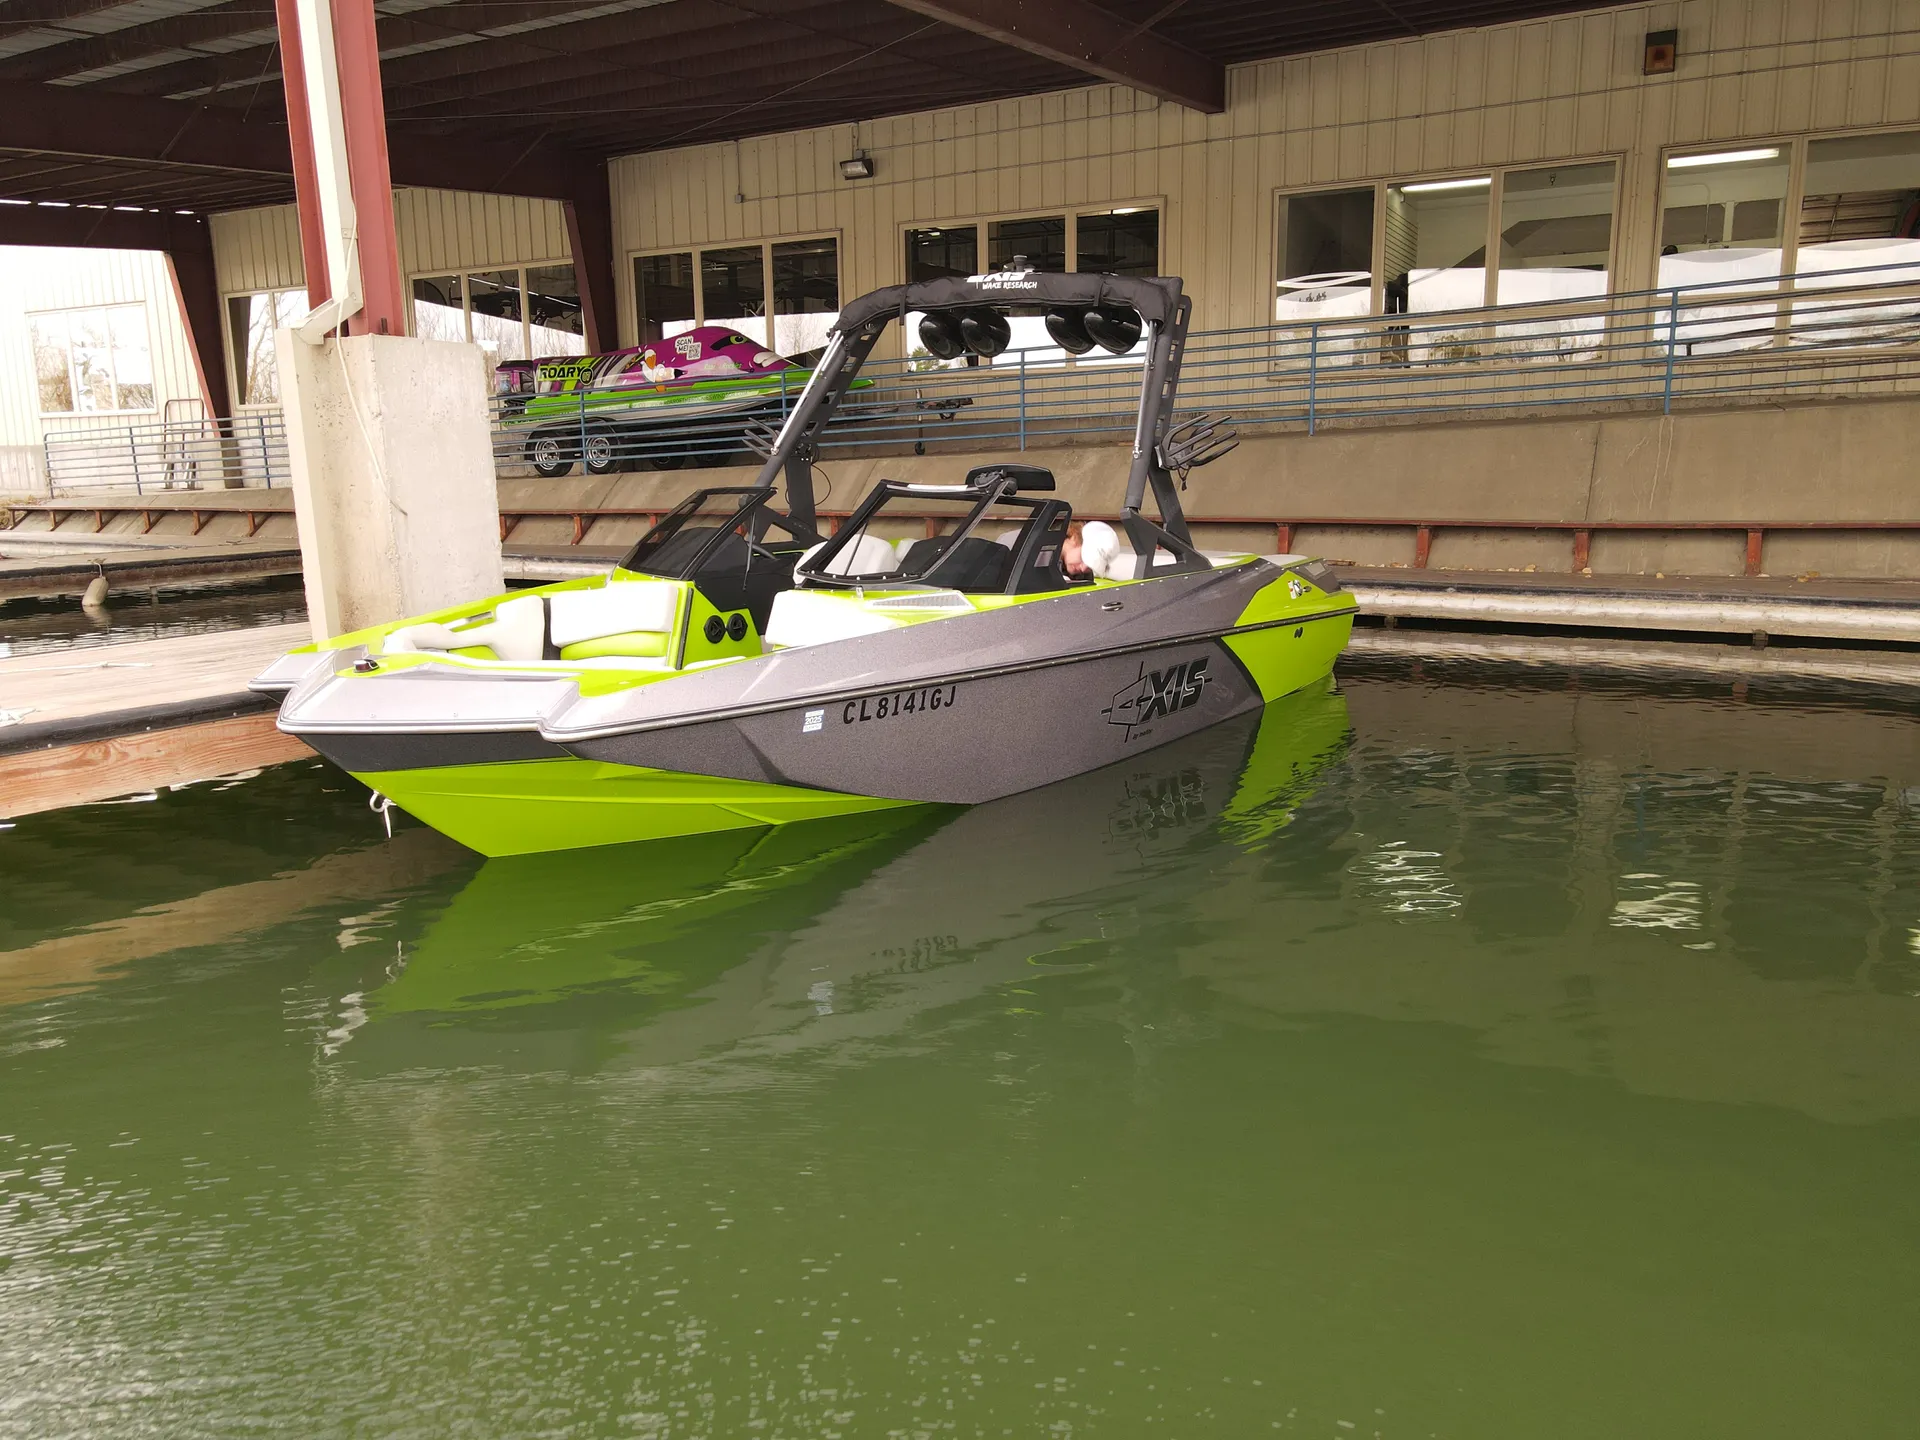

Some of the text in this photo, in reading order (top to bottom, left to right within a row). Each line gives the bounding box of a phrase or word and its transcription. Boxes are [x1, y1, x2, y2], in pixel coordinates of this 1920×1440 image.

[1003, 281, 1037, 289] RESEARCH
[677, 337, 692, 347] SCAN
[540, 366, 583, 378] ROARY
[843, 686, 956, 724] CL8141GJ
[804, 715, 822, 725] 2025
